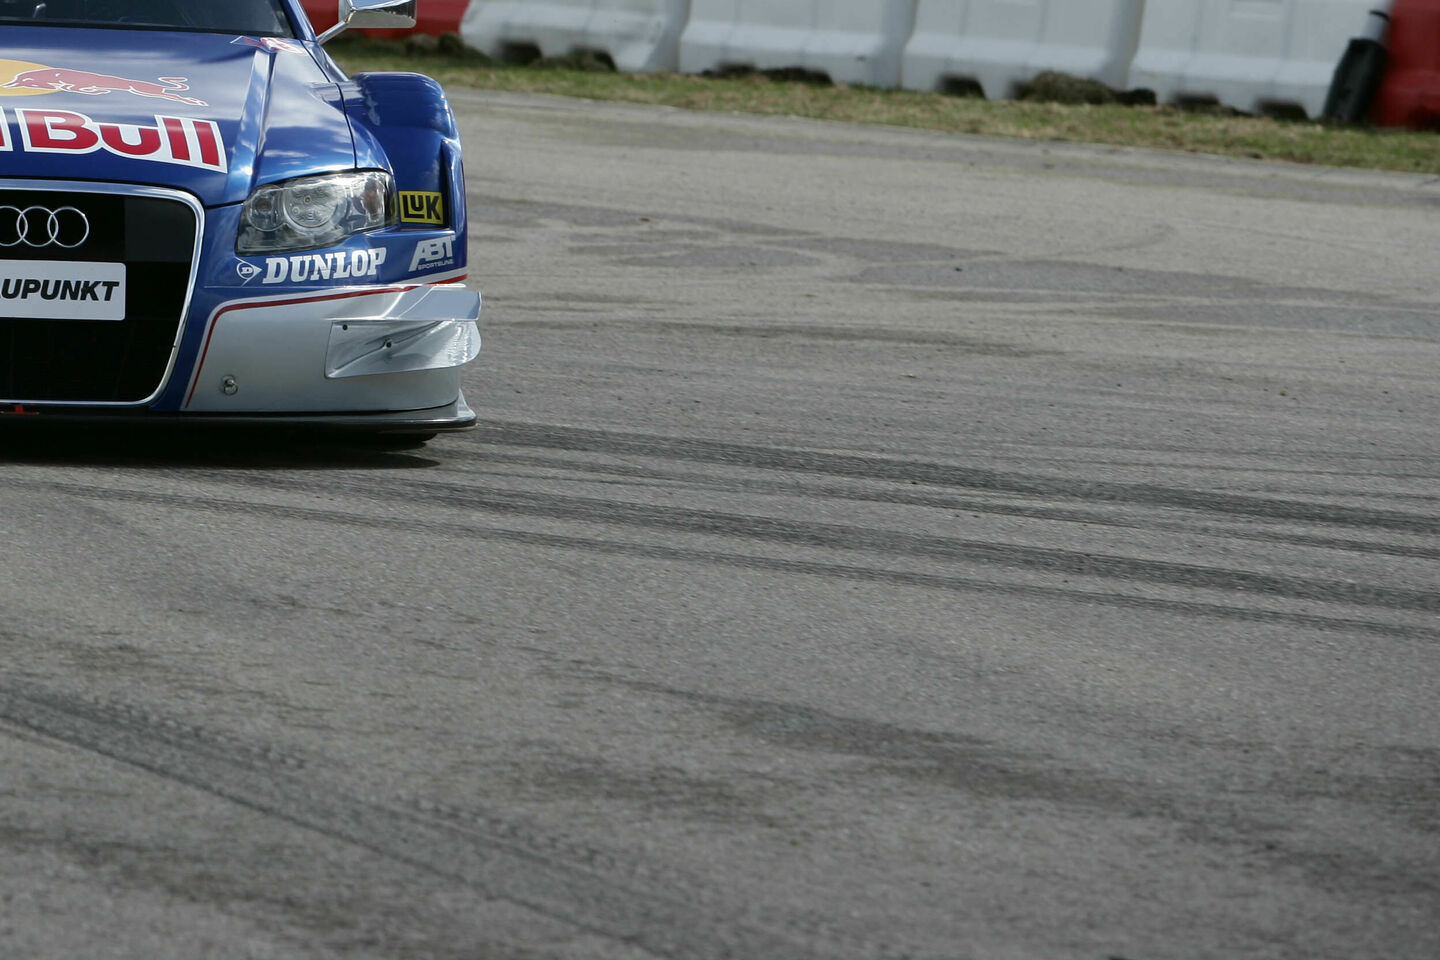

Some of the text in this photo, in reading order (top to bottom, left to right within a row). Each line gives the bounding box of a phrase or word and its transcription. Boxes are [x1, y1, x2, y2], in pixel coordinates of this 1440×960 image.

[19, 109, 223, 169] Bull
[262, 247, 387, 284] DUNLOP
[408, 236, 454, 272] ABT
